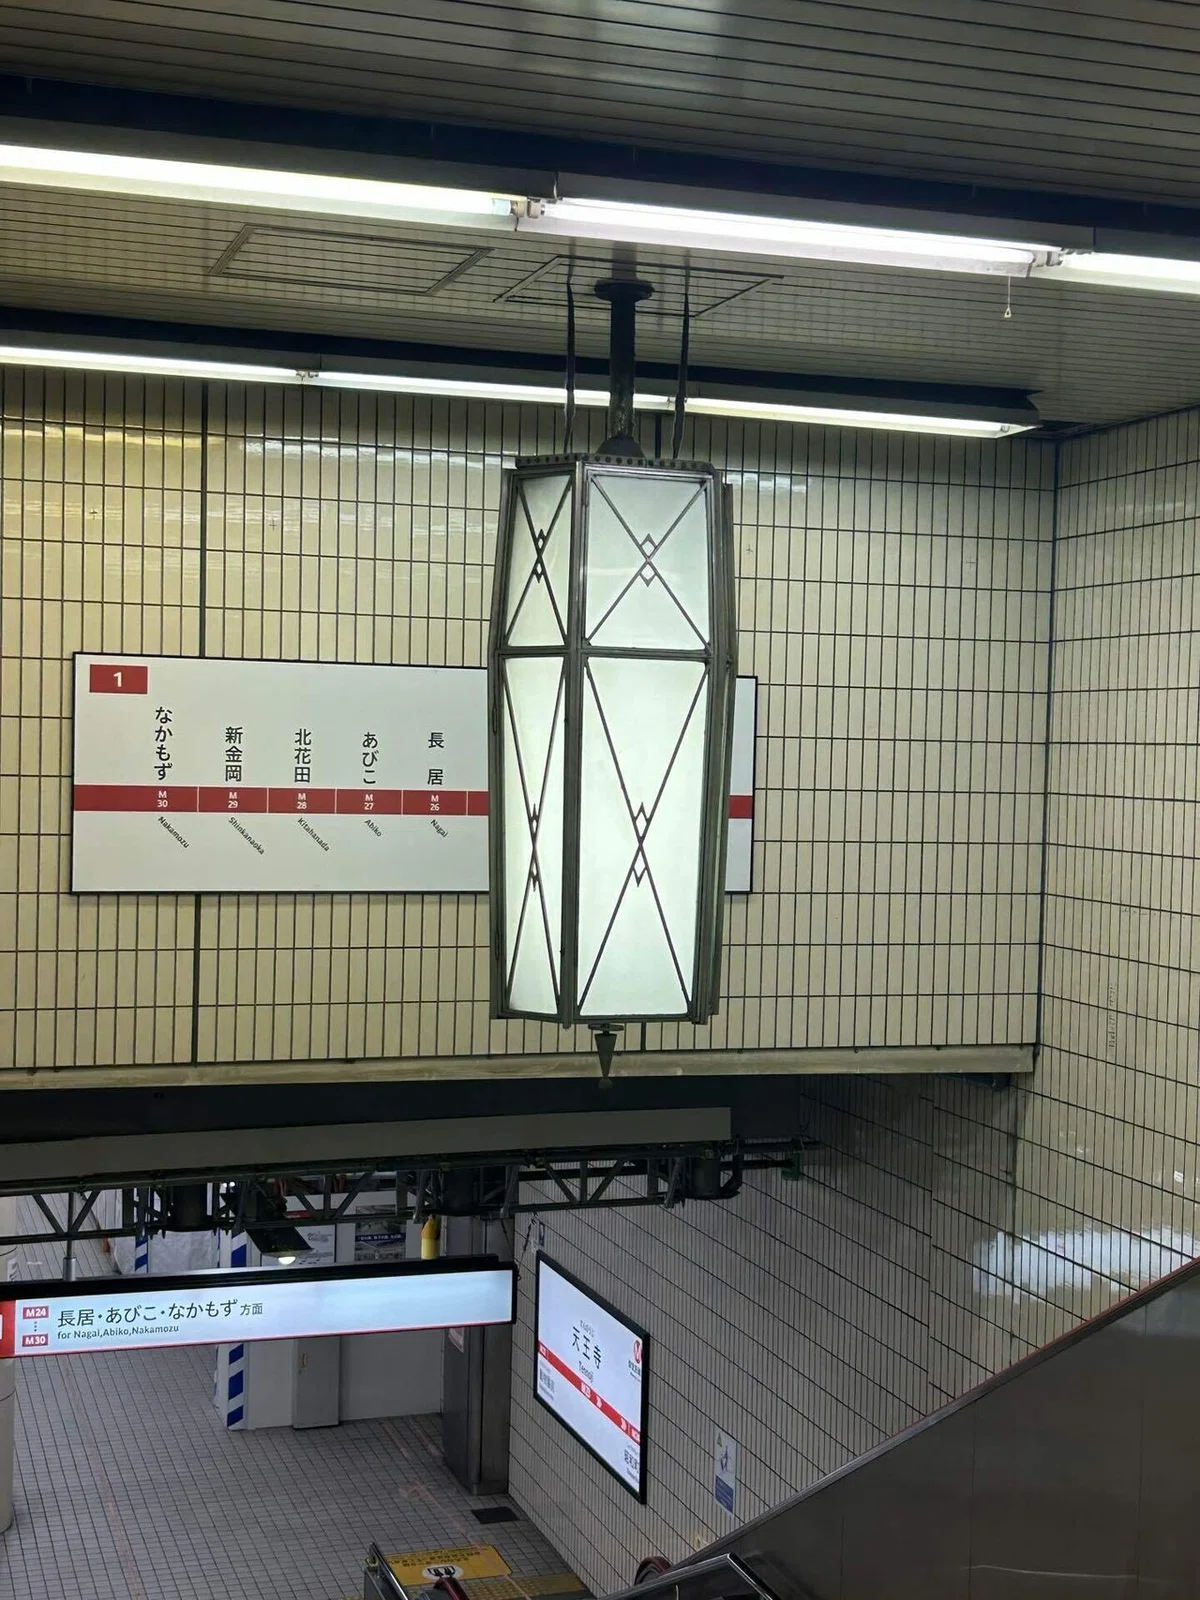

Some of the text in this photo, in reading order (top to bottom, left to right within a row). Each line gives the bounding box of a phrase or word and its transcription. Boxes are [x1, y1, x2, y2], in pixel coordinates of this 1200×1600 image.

[113, 671, 123, 688] 1
[154, 706, 173, 781] なかもず
[225, 726, 243, 782] 新金岡
[294, 728, 311, 784] 北花田
[362, 731, 379, 785] あびこ
[157, 799, 169, 808] 30
[227, 801, 239, 810] 29
[296, 801, 308, 810] 28
[363, 803, 375, 812] 27
[429, 804, 441, 813] 26
[158, 816, 190, 849] Nakamozu
[228, 816, 265, 855] Shinkanaoka
[297, 817, 330, 852] Kitahanada
[364, 819, 382, 837] Abiko
[430, 819, 449, 838] Nagai
[26, 1308, 46, 1318] M24
[24, 1335, 46, 1346] M30
[57, 1330, 71, 1340] for
[572, 1325, 602, 1370] 天王寺
